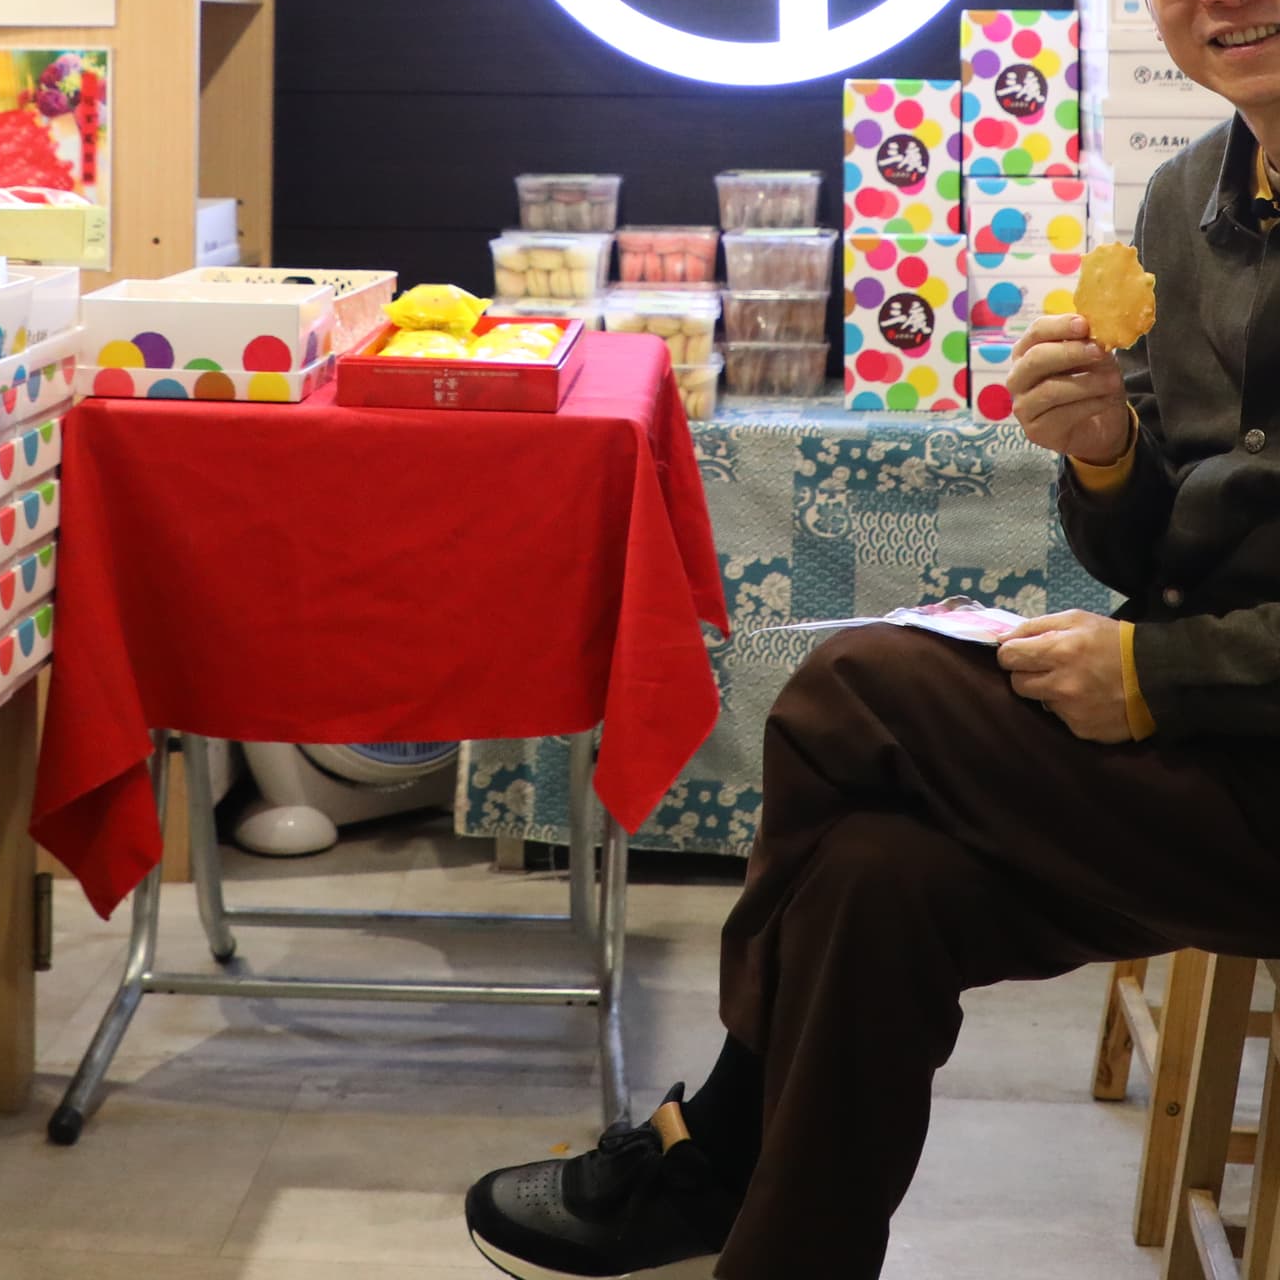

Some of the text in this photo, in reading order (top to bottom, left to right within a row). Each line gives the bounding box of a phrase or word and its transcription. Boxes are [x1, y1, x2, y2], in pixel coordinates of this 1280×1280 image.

[995, 70, 1046, 102] 三廣
[876, 140, 929, 174] 三廣
[879, 300, 933, 335] 三廣
